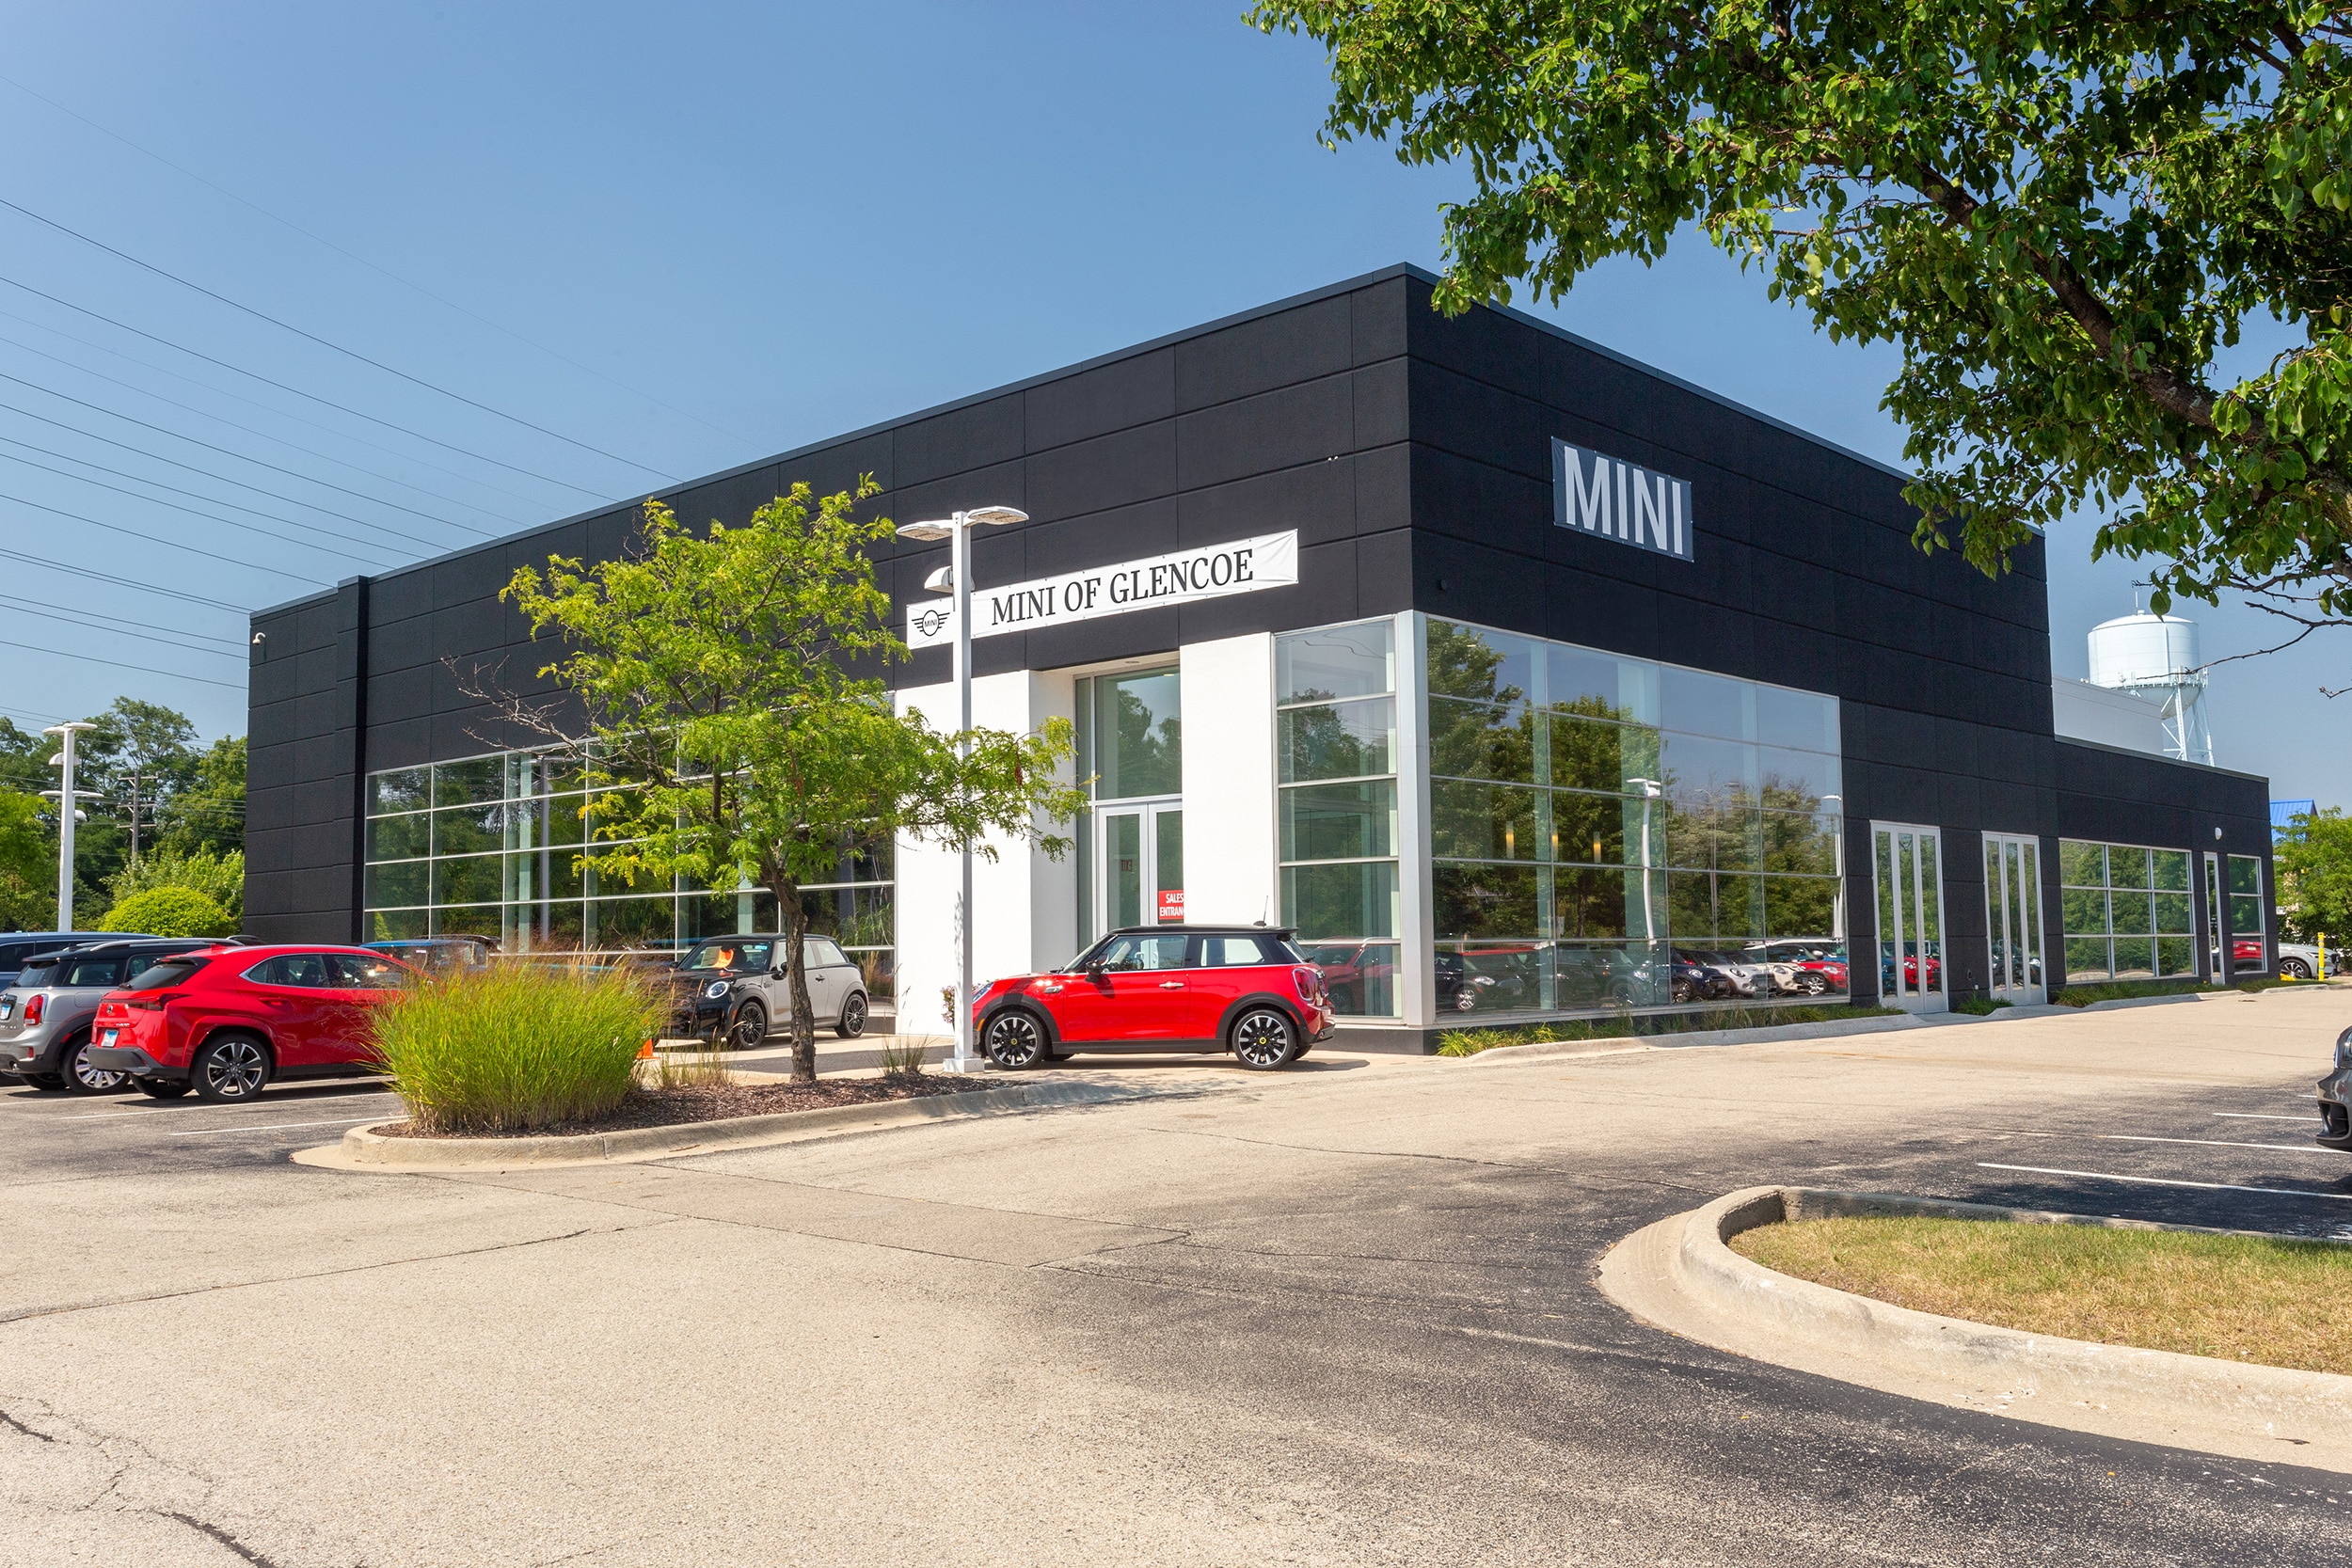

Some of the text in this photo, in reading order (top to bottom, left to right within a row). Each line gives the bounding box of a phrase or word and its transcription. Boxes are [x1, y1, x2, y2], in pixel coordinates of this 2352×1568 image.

[1564, 445, 1683, 555] MINI
[991, 548, 1254, 626] MINI OF GLENCOE
[924, 618, 938, 628] MINI
[1166, 893, 1184, 904] SALES
[1159, 906, 1184, 917] ENTRAN
